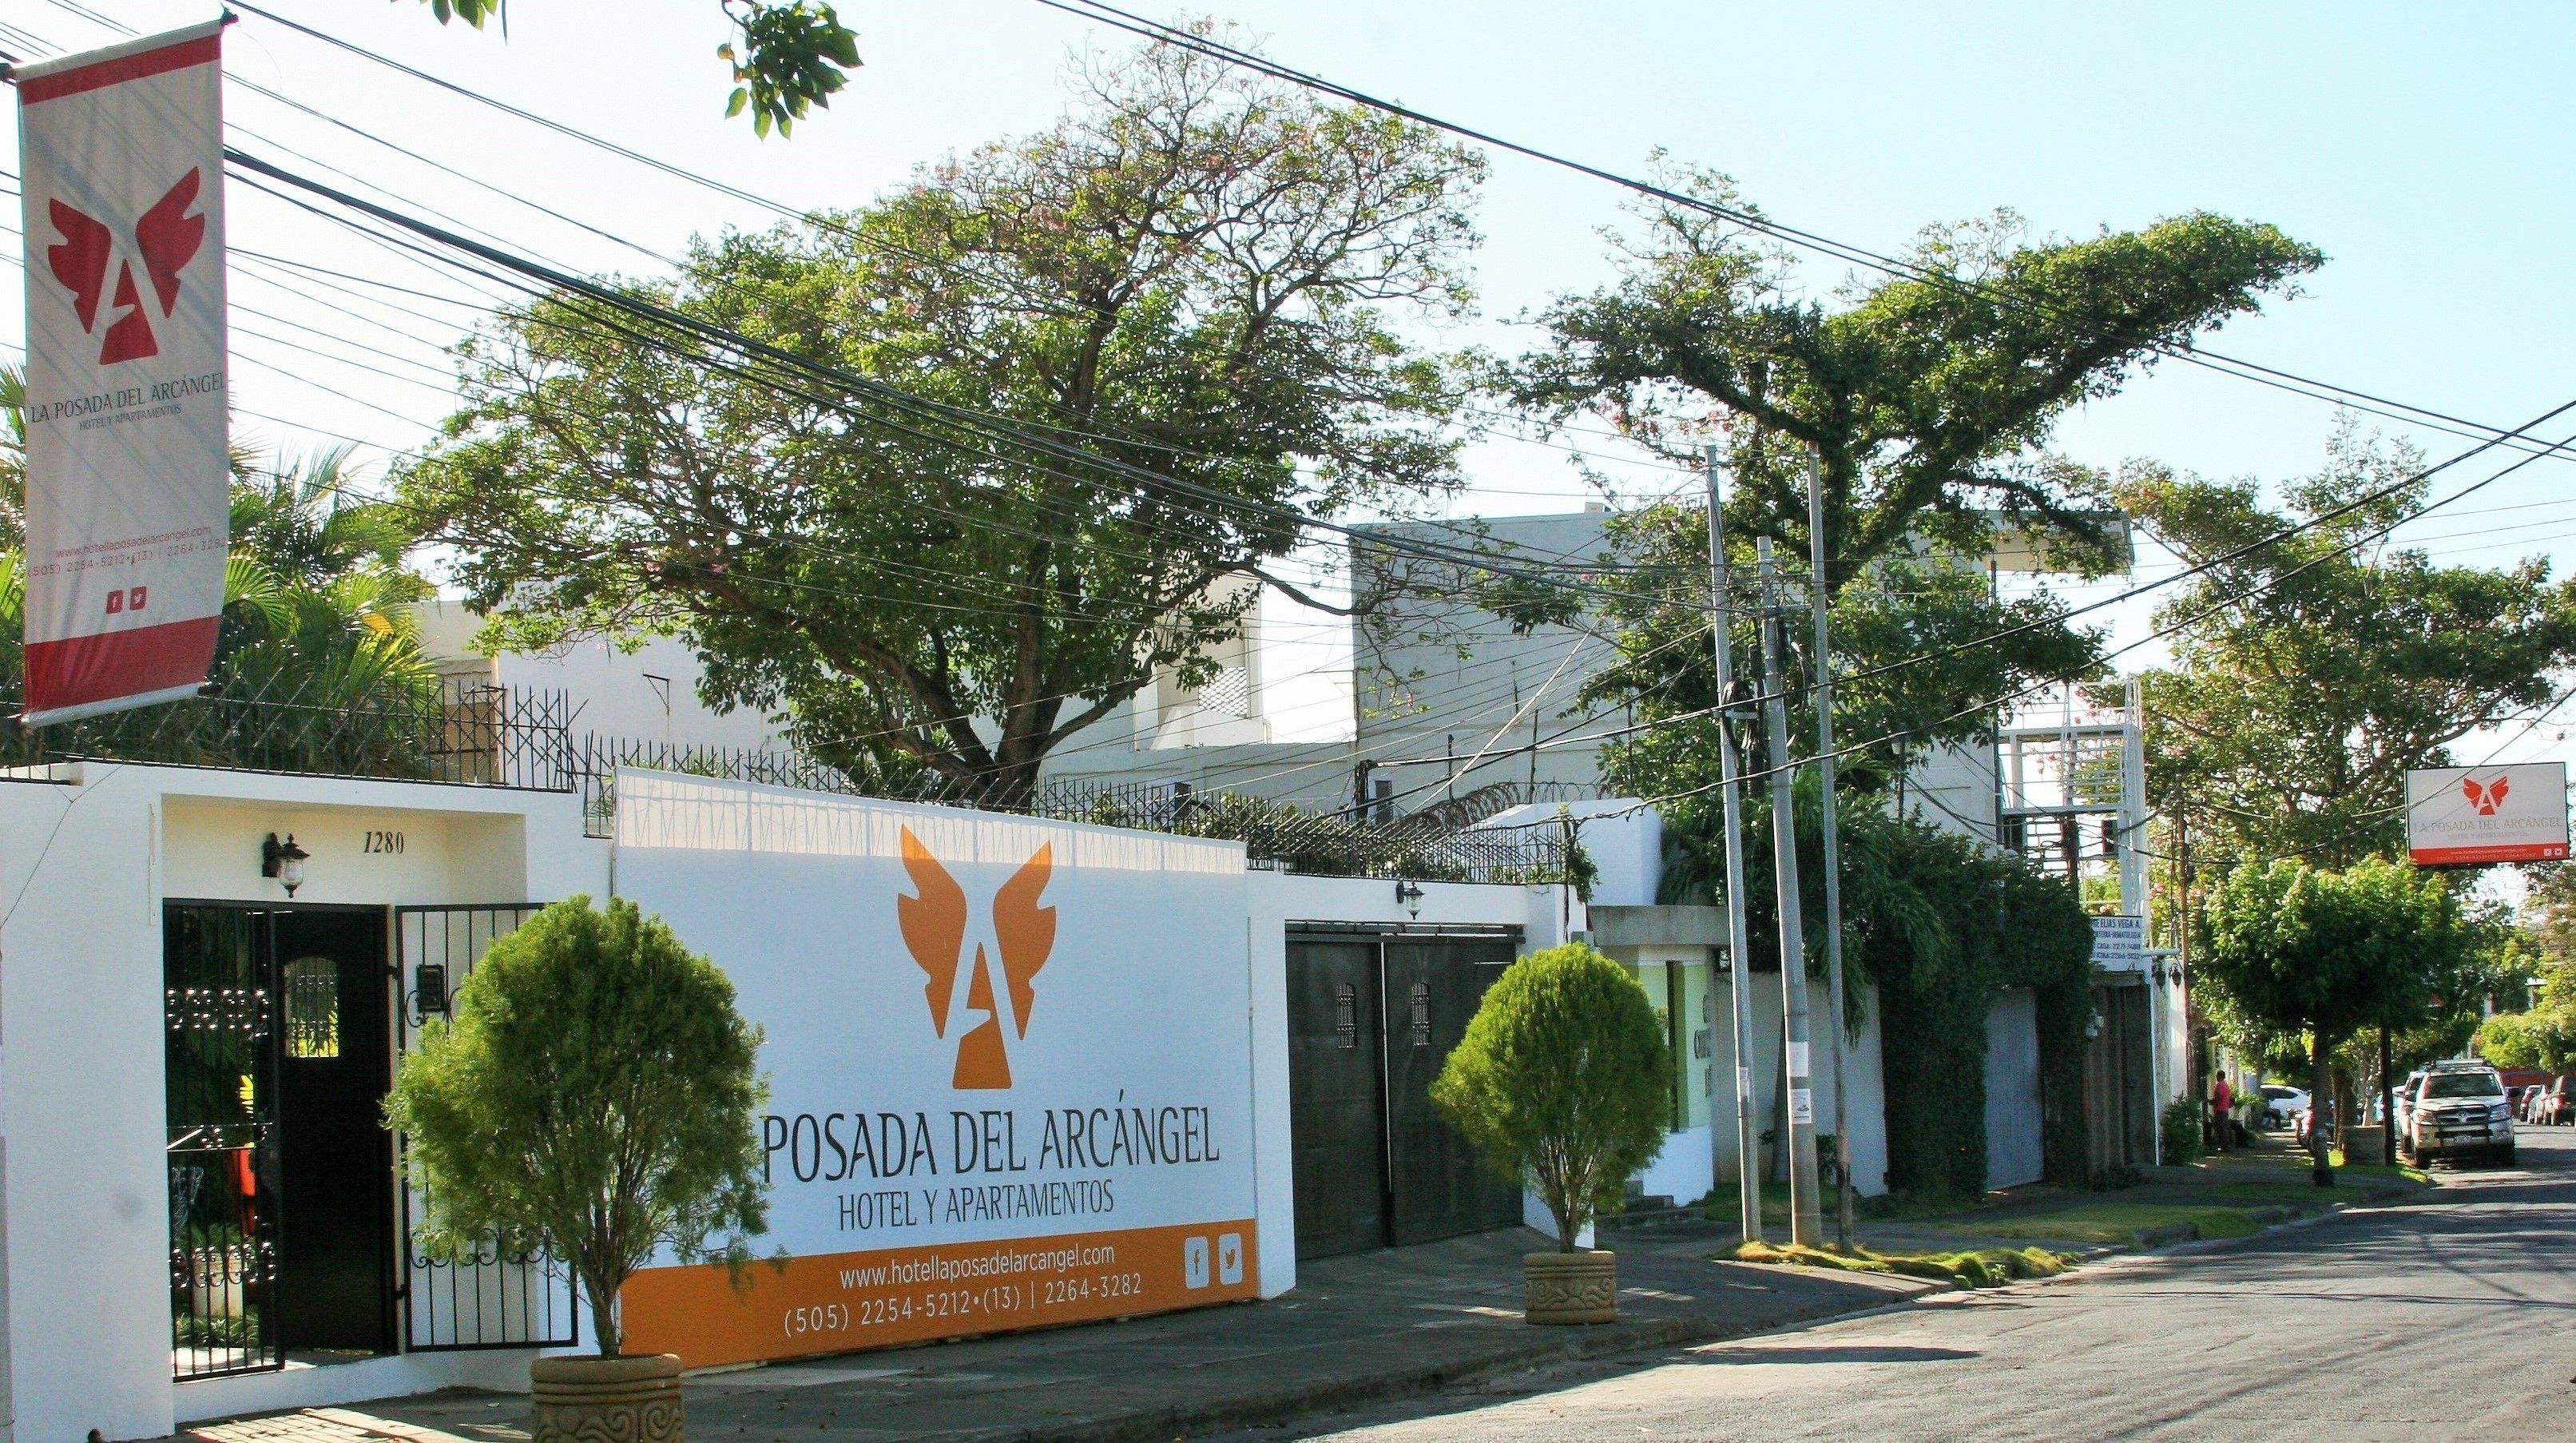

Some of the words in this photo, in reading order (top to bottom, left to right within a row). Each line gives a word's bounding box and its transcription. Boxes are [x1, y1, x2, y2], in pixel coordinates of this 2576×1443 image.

[30, 405, 50, 423] LA
[55, 395, 113, 418] POSADA
[117, 388, 145, 408] DEL
[150, 372, 225, 401] ARCÁNGEL
[79, 417, 106, 431] HOTEL
[115, 403, 182, 423] APARTAMENTOS
[363, 831, 405, 854] 1280
[2431, 821, 2475, 832] POSADA
[2479, 819, 2500, 830] DEL
[2504, 816, 2563, 829] ARCÁNGEL
[759, 1111, 938, 1184] POSADA
[950, 1110, 1026, 1174] DEL
[1039, 1088, 1220, 1170] ARCÁNGEL
[838, 1191, 917, 1230] HOTEL
[923, 1189, 938, 1225] Y
[946, 1179, 1114, 1224] APARTAMENTOS
[839, 1243, 1114, 1289] www.hotellaposadelarcangel.com
[784, 1303, 849, 1338] (505)
[1045, 1273, 1141, 1306] 2264-3282
